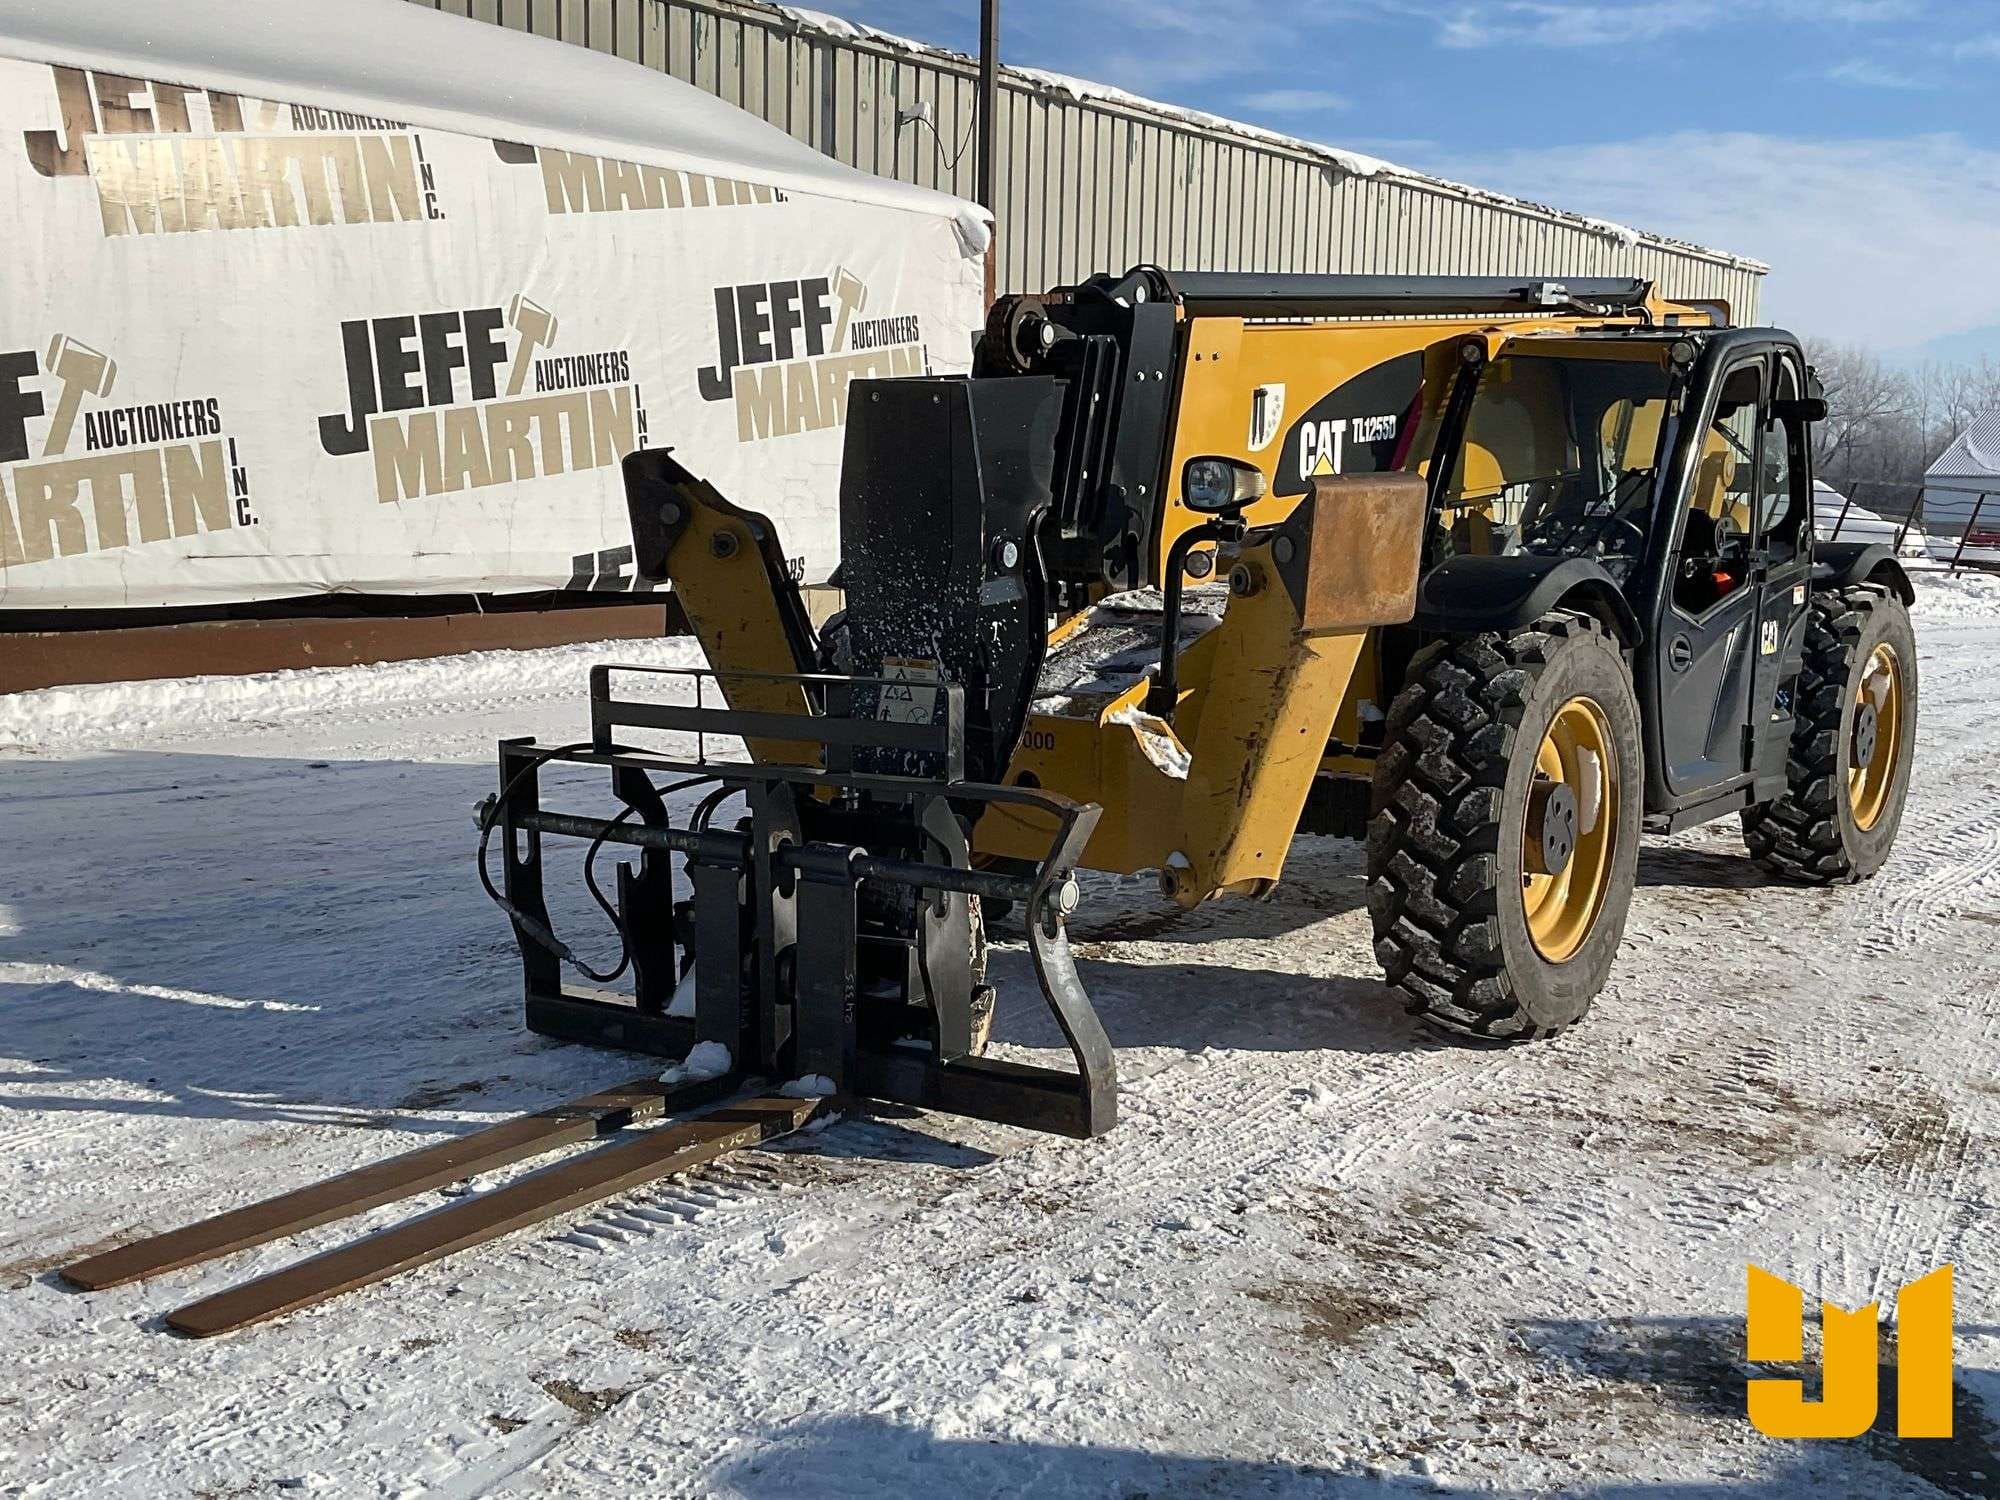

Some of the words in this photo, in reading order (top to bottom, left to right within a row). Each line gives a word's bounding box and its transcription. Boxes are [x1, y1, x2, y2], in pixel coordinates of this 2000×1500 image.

[87, 136, 423, 236] MARTIN
[697, 277, 832, 401] JEFF
[851, 315, 919, 350] AUCTIONEERS
[318, 308, 509, 456] JEFF
[535, 350, 630, 392] AUCTIONEERS
[85, 398, 221, 451] AUCTIONEERS
[370, 386, 635, 503] MARTIN
[1300, 419, 1347, 482] CAT
[1352, 415, 1397, 443] TL1255D
[228, 437, 258, 527] INC.
